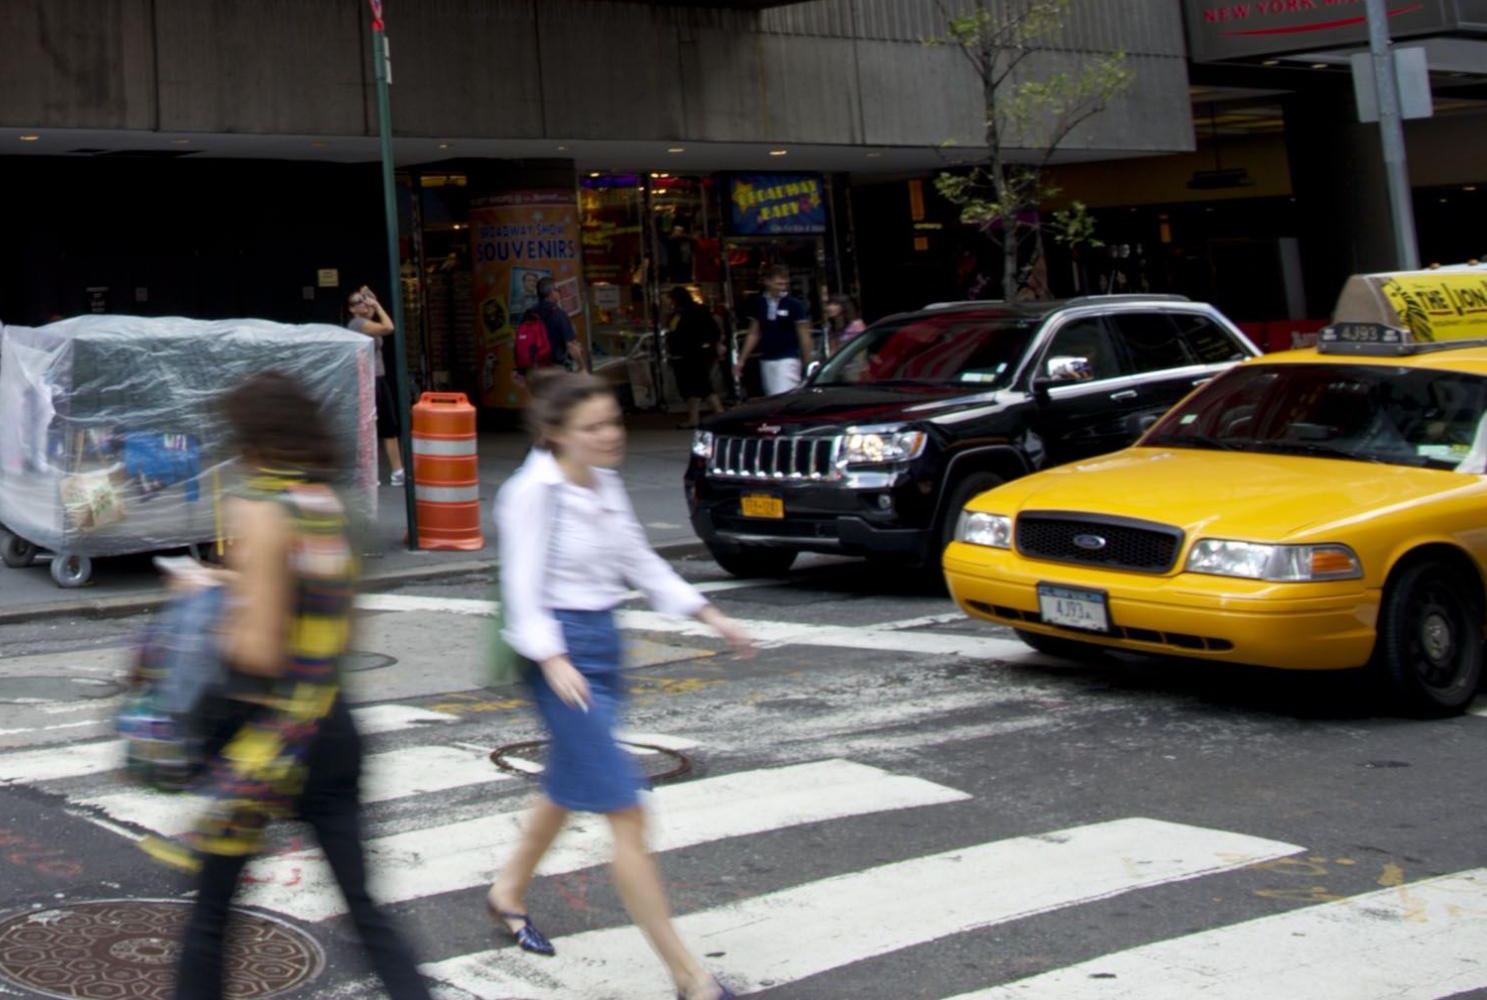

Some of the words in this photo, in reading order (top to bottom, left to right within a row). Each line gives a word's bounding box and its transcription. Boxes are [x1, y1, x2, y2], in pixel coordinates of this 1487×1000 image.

[1202, 4, 1250, 23] NEW
[476, 239, 577, 262] SOUVENIRS
[1341, 325, 1379, 341] 4J93
